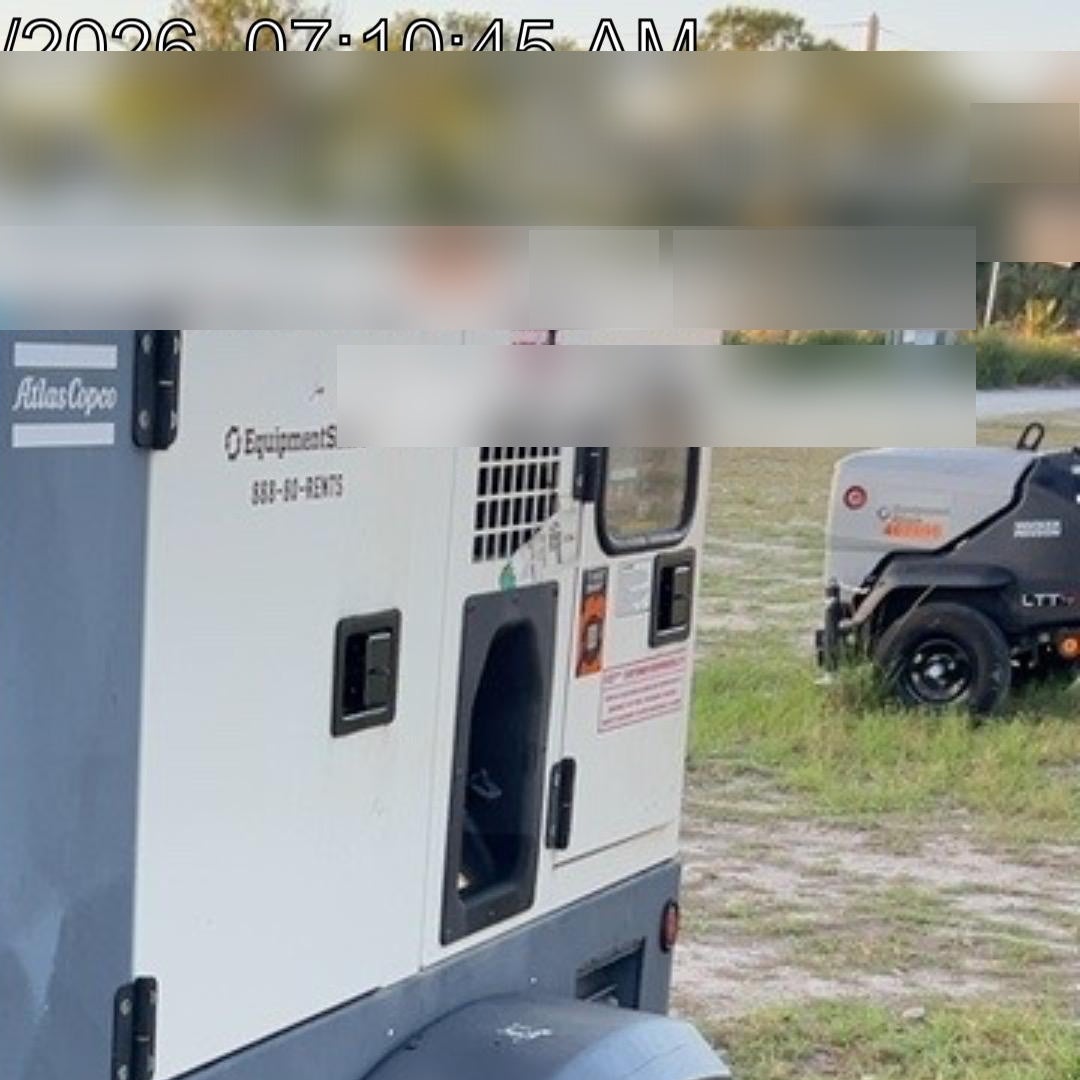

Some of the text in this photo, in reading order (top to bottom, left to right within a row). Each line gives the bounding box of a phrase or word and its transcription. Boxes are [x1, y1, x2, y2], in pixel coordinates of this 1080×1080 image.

[12, 376, 118, 416] Atlas Copco
[245, 424, 338, 460] EquipmentS
